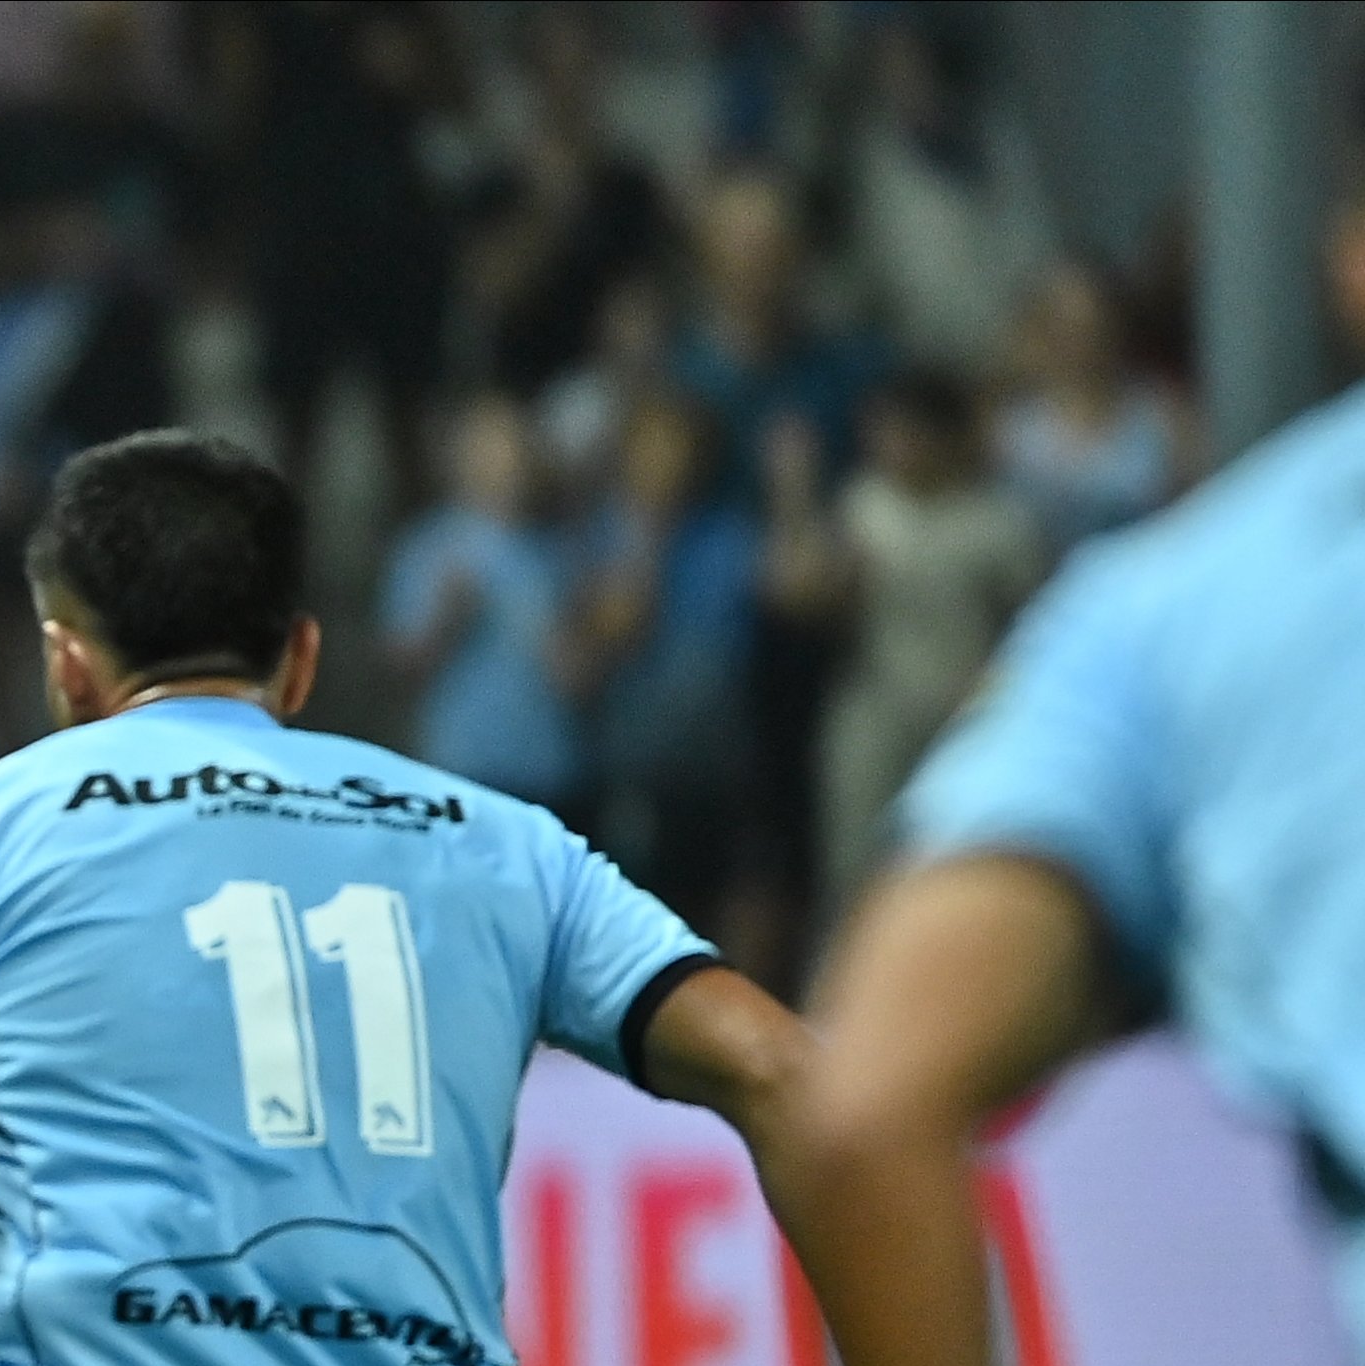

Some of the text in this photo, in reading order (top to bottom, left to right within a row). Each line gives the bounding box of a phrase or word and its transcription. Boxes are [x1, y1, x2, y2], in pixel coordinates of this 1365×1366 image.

[64, 763, 465, 823] Auto Sol
[182, 879, 435, 1158] 11
